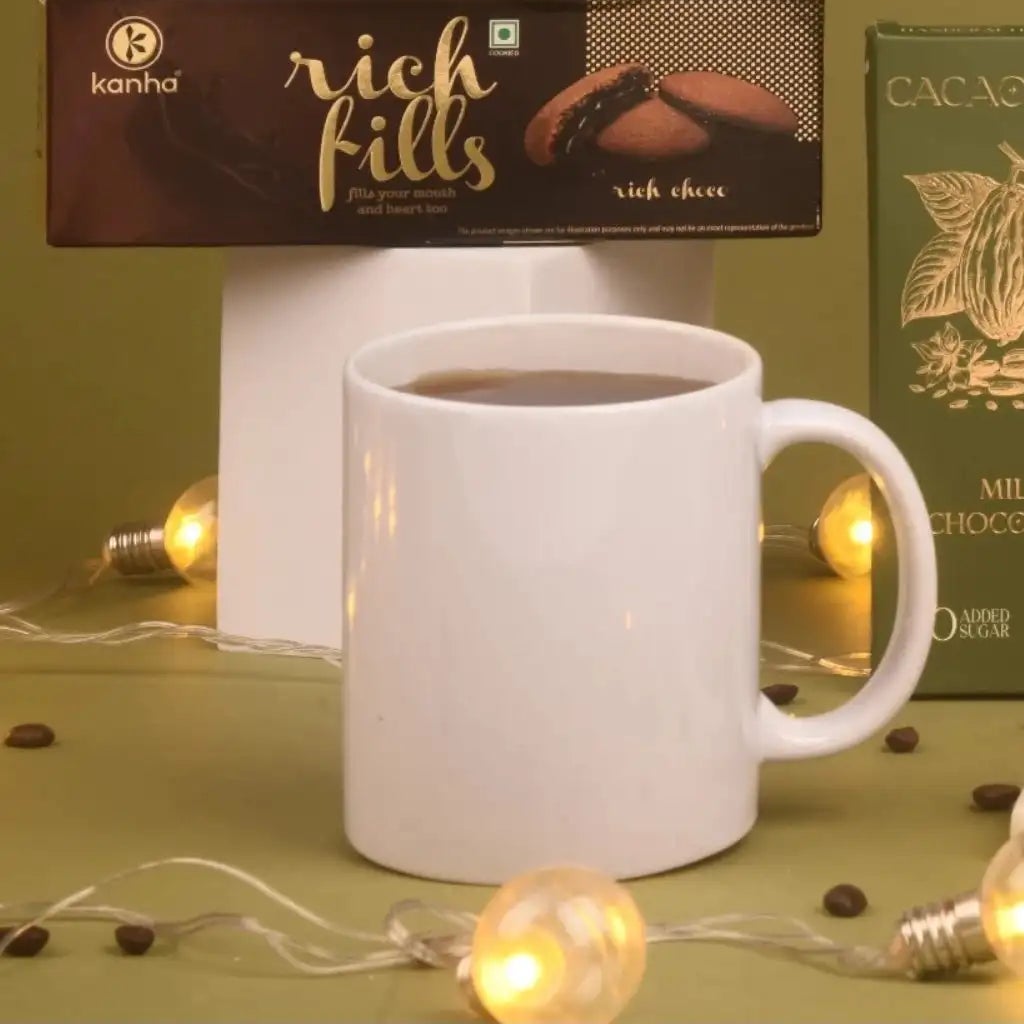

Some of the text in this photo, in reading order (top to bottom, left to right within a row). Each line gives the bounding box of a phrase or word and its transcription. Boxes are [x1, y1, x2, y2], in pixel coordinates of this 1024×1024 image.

[284, 16, 498, 112] rich
[91, 70, 178, 94] kanha
[319, 95, 496, 212] fills
[346, 186, 457, 203] fills your mouth
[612, 176, 661, 201] rich
[357, 204, 383, 215] and
[959, 608, 1010, 623] ADDED
[959, 624, 1010, 639] SUGAR
